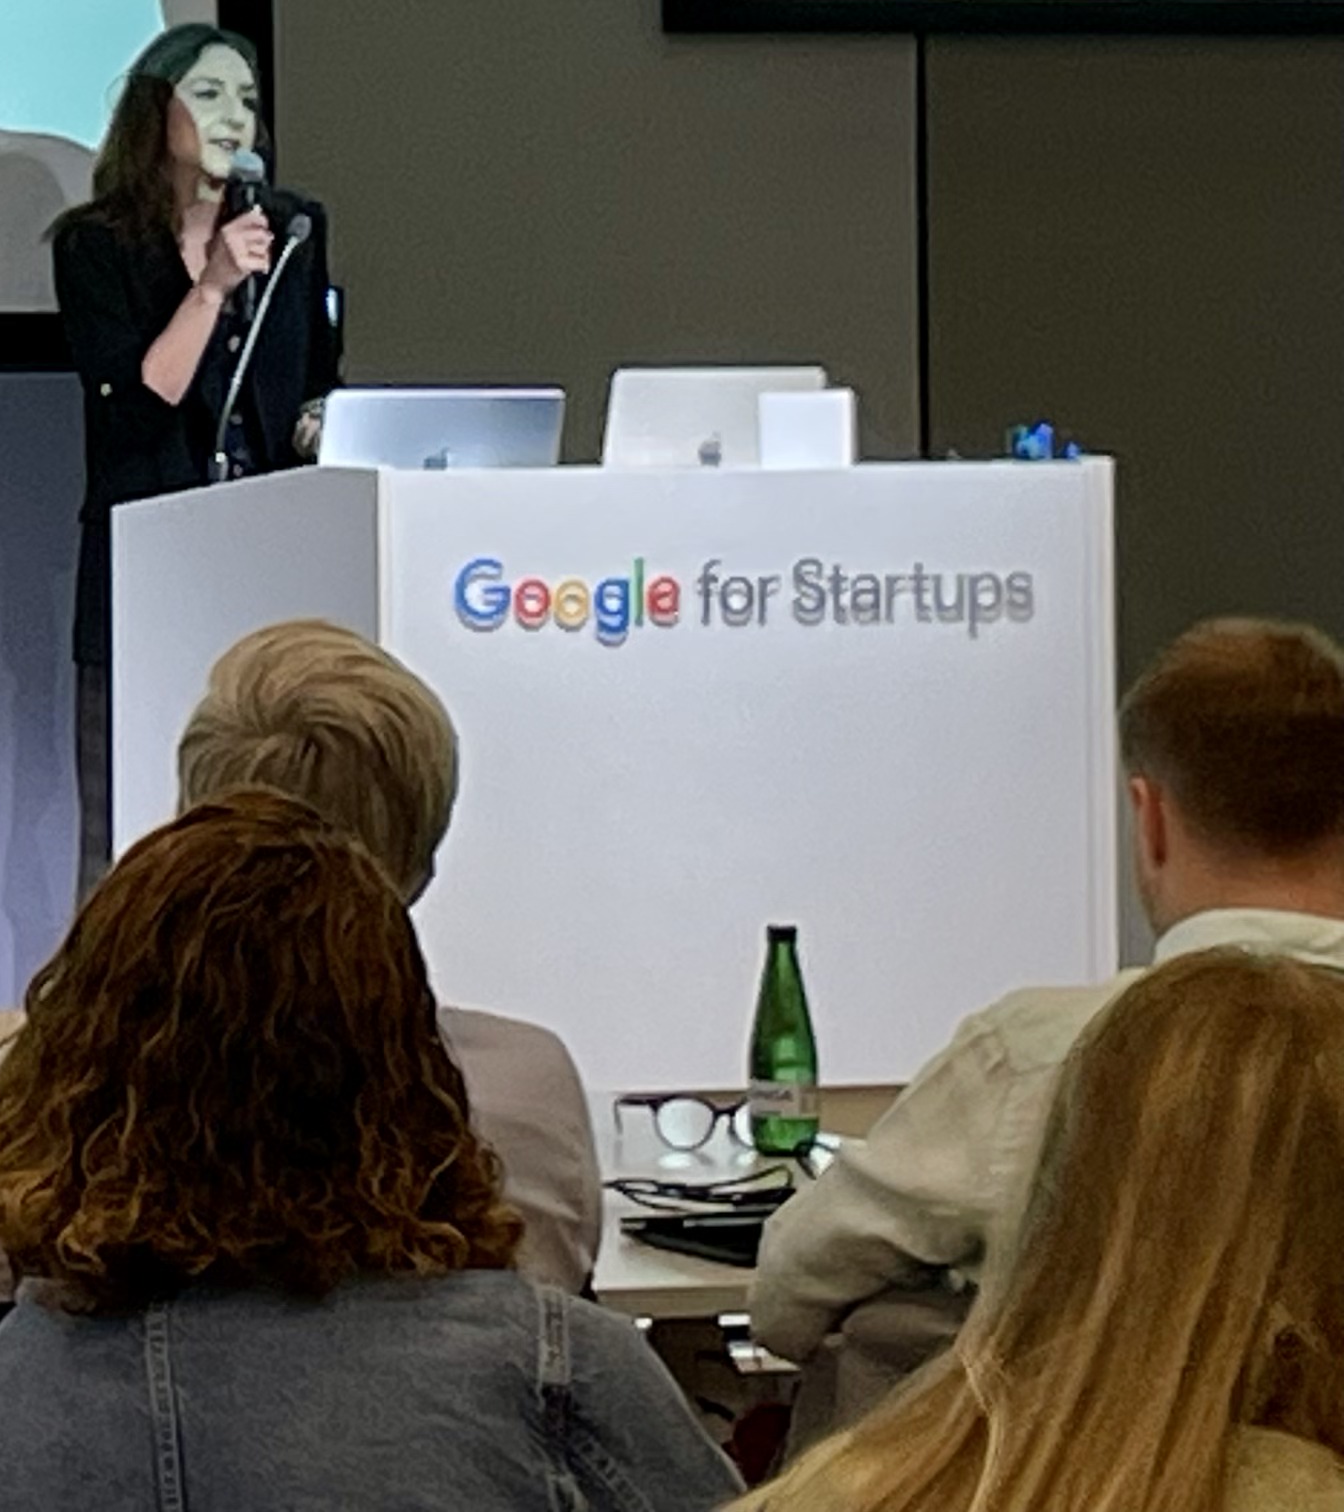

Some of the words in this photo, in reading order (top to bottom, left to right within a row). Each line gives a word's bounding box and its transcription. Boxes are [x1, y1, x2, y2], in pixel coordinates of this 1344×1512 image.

[453, 557, 682, 648] Google
[696, 558, 781, 629] for
[791, 557, 1036, 640] Startups
